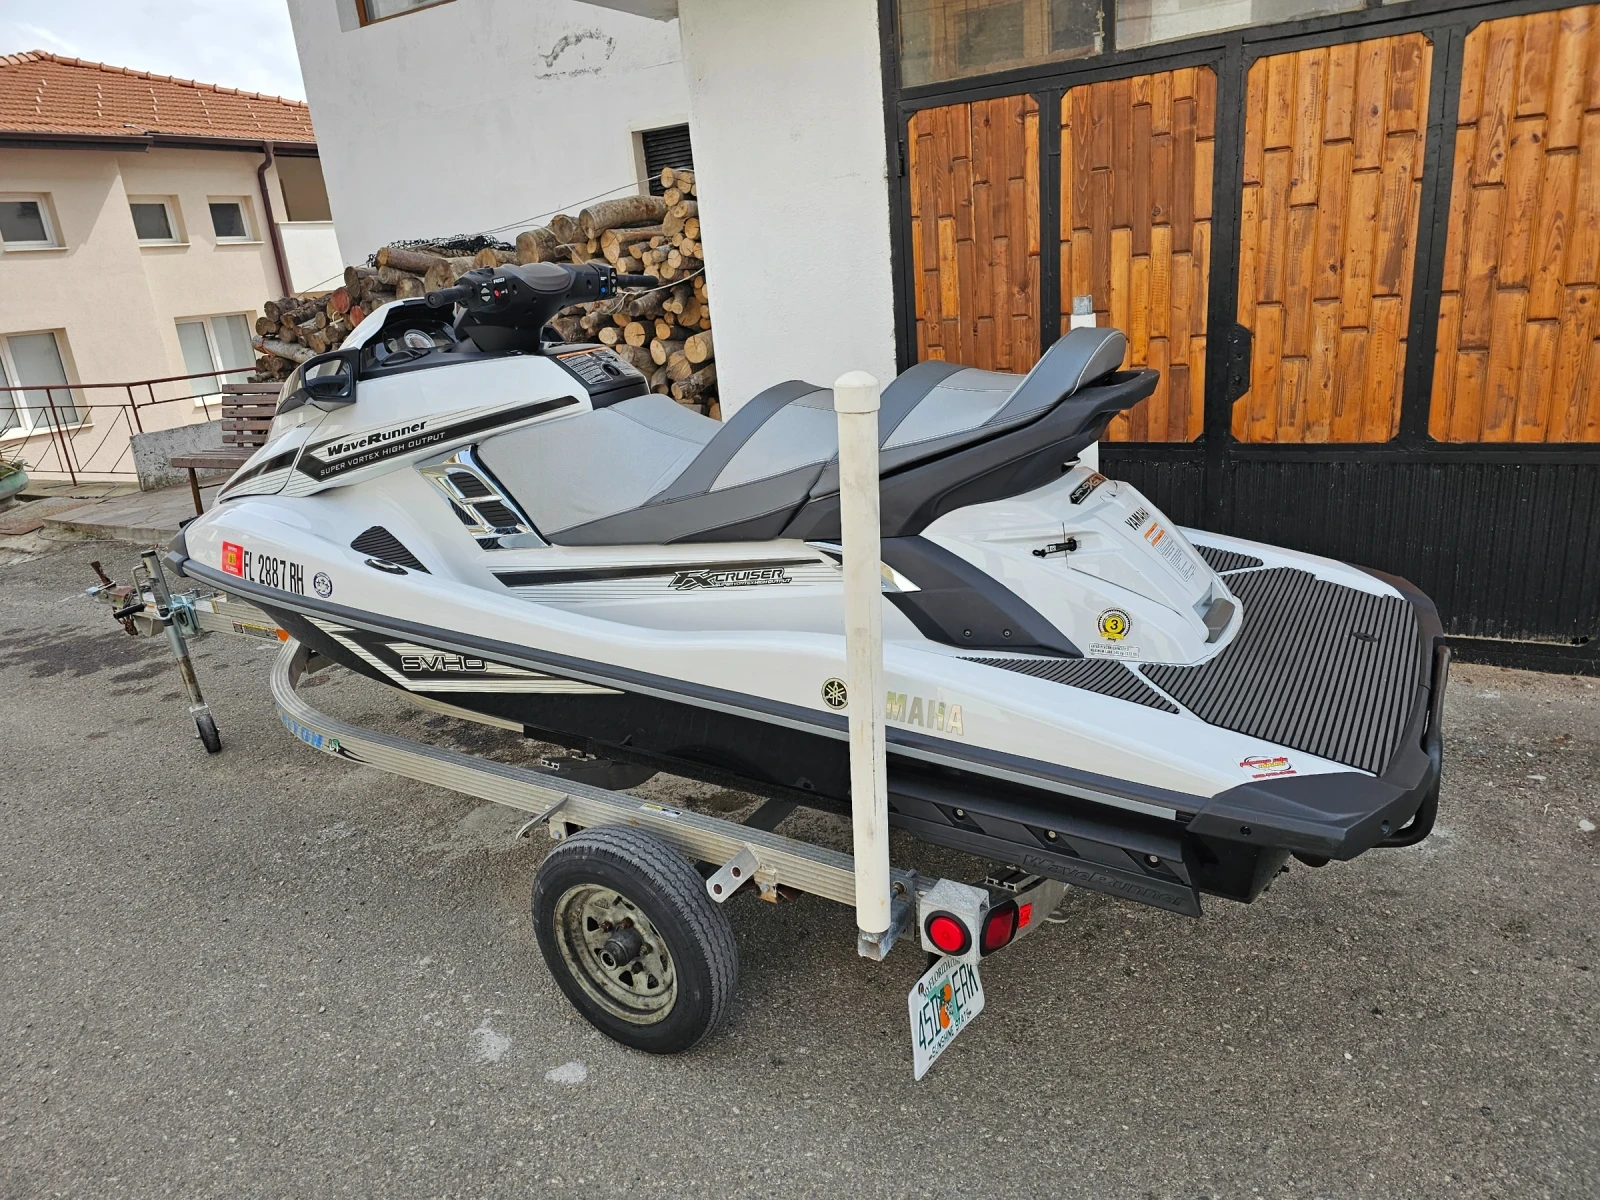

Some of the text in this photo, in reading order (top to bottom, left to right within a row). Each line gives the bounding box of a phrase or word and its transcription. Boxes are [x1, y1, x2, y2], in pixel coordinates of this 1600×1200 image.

[320, 431, 446, 476] SUPER VORTEX HIGH OUTPUT
[327, 420, 427, 457] WaveRunner
[243, 550, 255, 581] FL
[258, 554, 286, 591] 2887
[289, 562, 304, 596] RH
[667, 568, 783, 591] FX CRUISER
[1109, 619, 1119, 630] 3
[401, 654, 488, 672] SVHO
[885, 690, 964, 736] MAHA
[1023, 853, 1189, 906] WaveRunner
